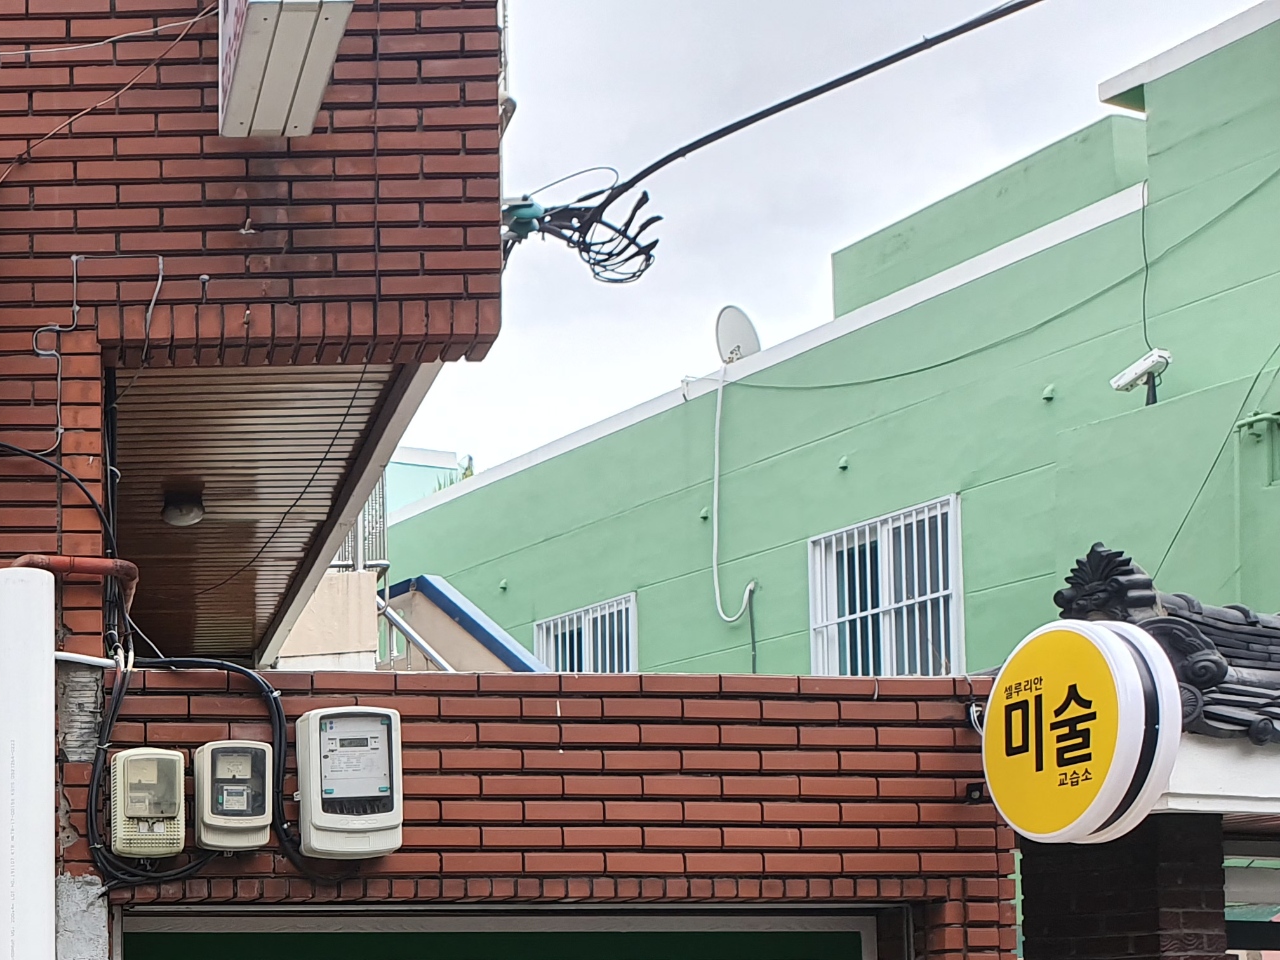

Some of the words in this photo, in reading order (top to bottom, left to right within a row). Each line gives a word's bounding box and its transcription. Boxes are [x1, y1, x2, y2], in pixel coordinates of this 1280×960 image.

[1004, 676, 1043, 700] 셀루리안
[1004, 683, 1097, 772] 미술
[1057, 767, 1093, 787] 교습소
